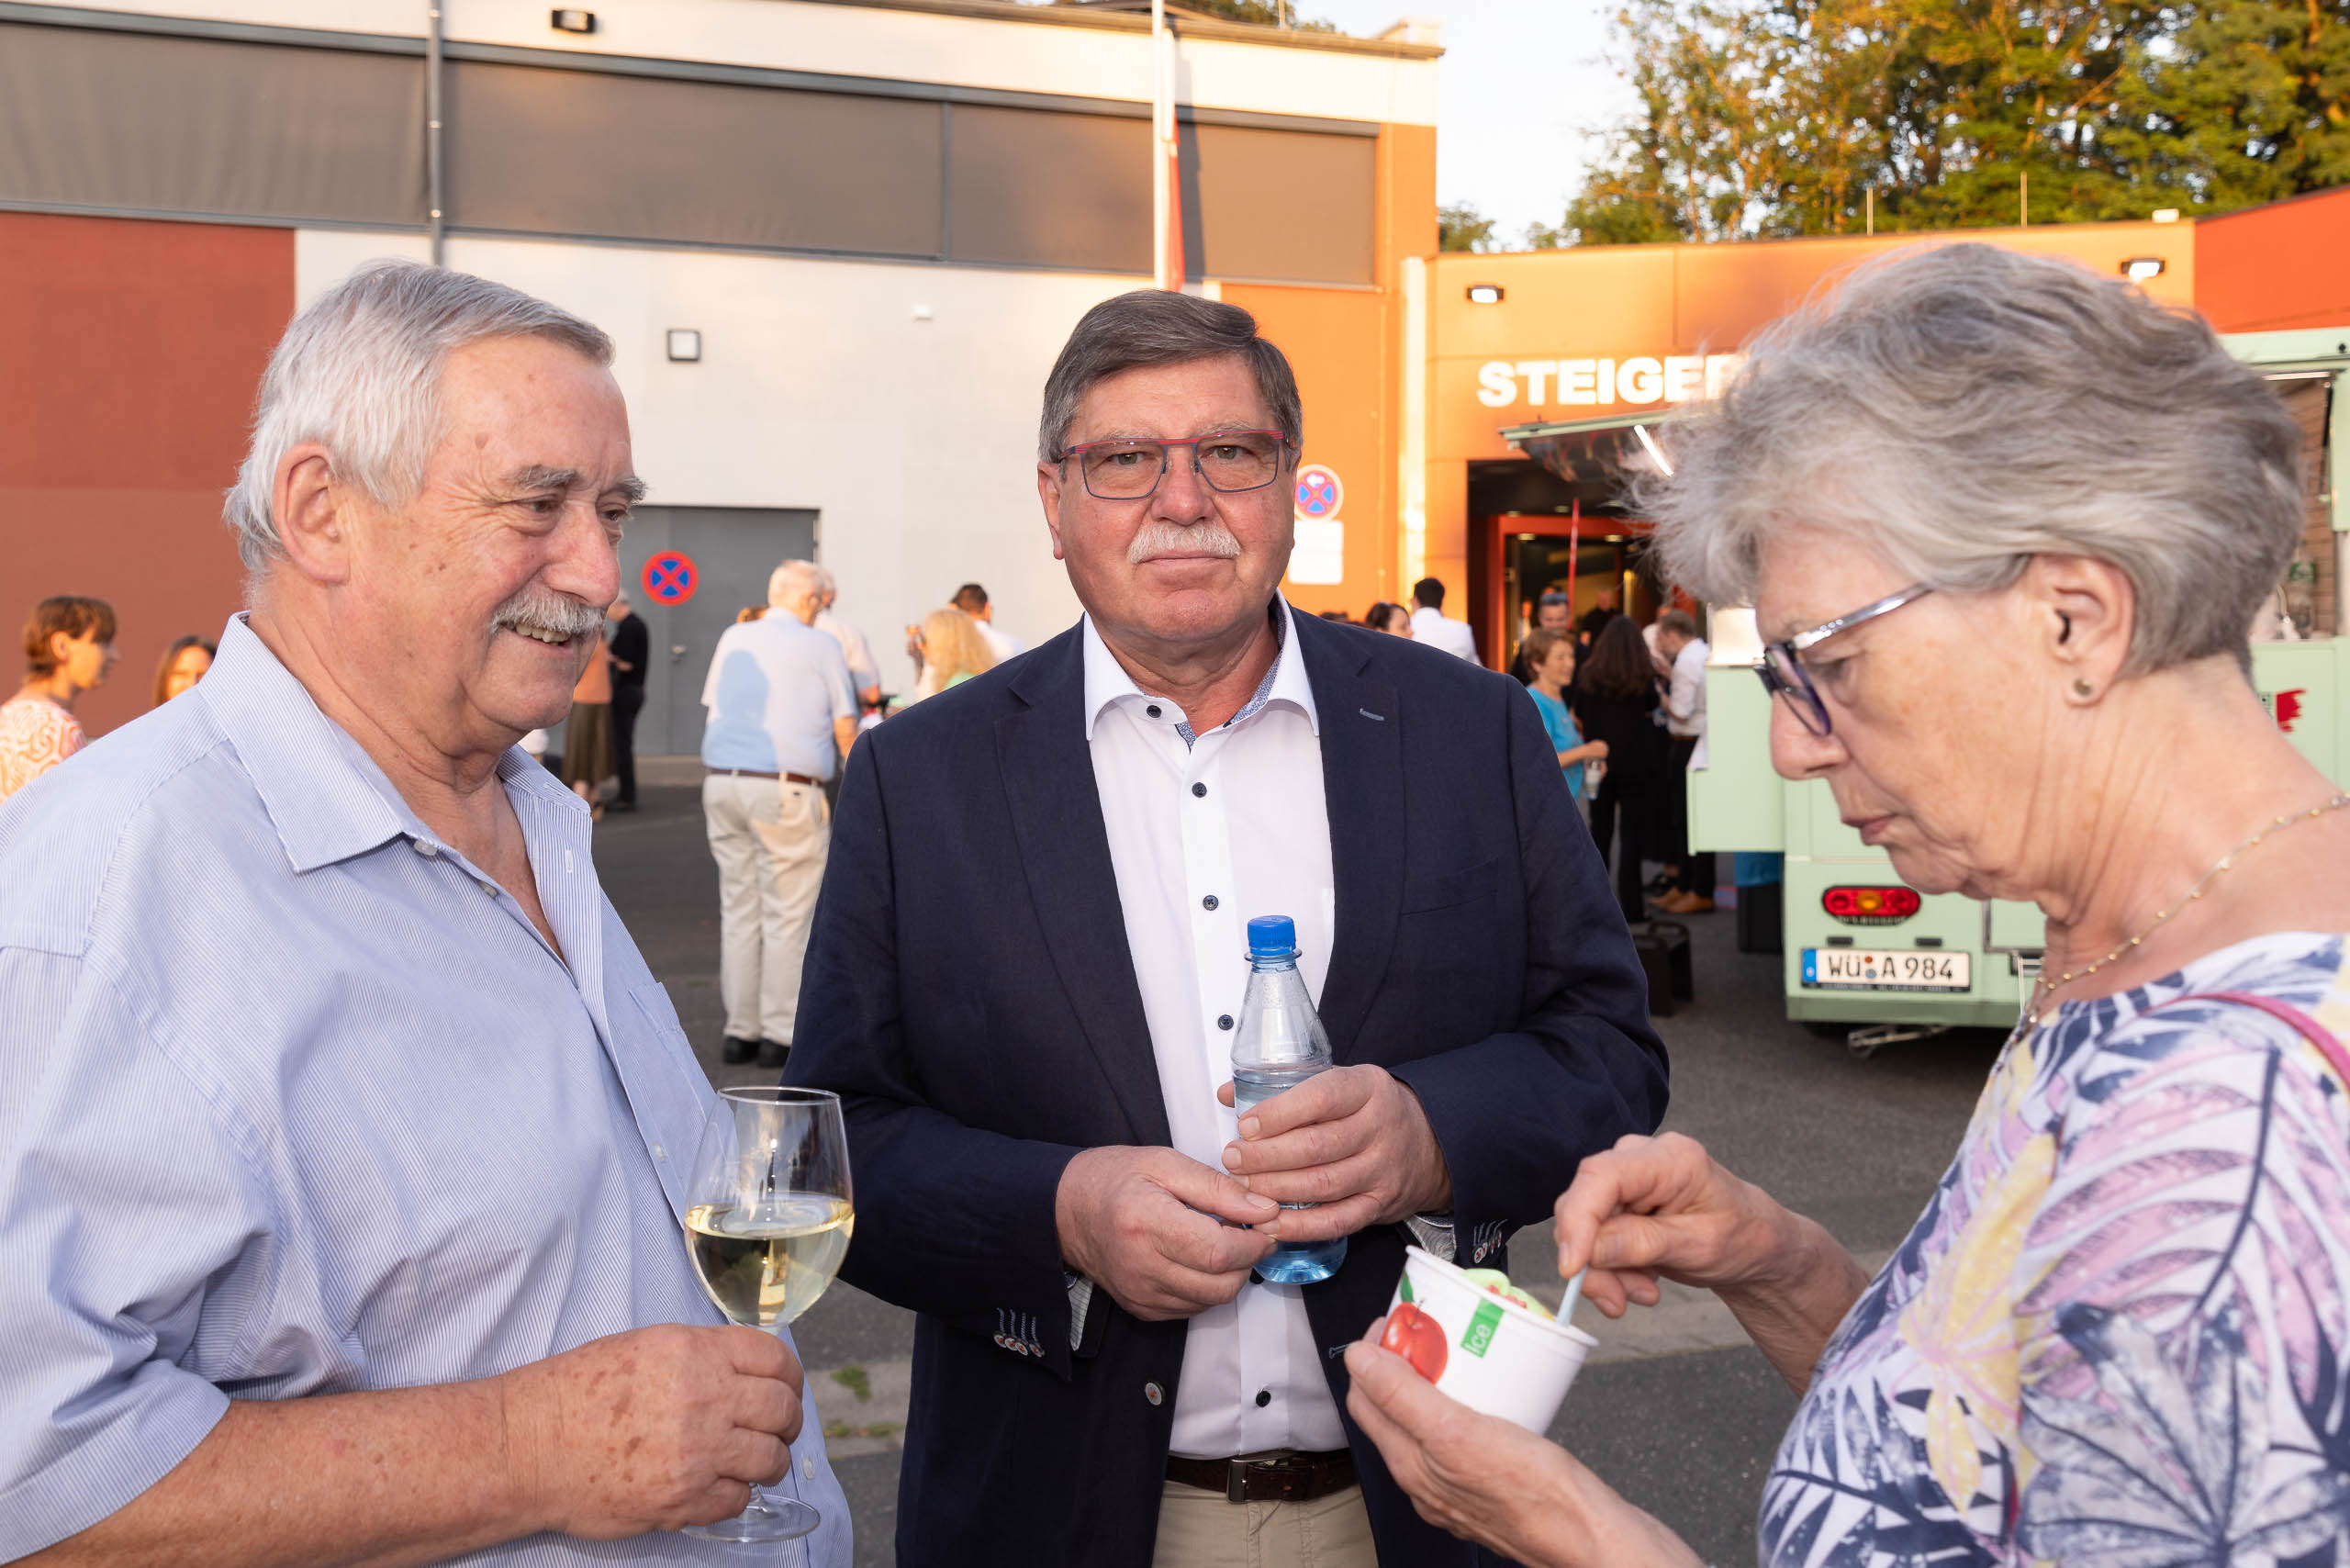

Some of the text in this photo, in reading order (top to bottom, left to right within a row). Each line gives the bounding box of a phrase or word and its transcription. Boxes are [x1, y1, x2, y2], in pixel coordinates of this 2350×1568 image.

[1828, 954, 1861, 978] WÜ
[1882, 957, 1896, 978] A
[1905, 958, 1953, 980] 984
